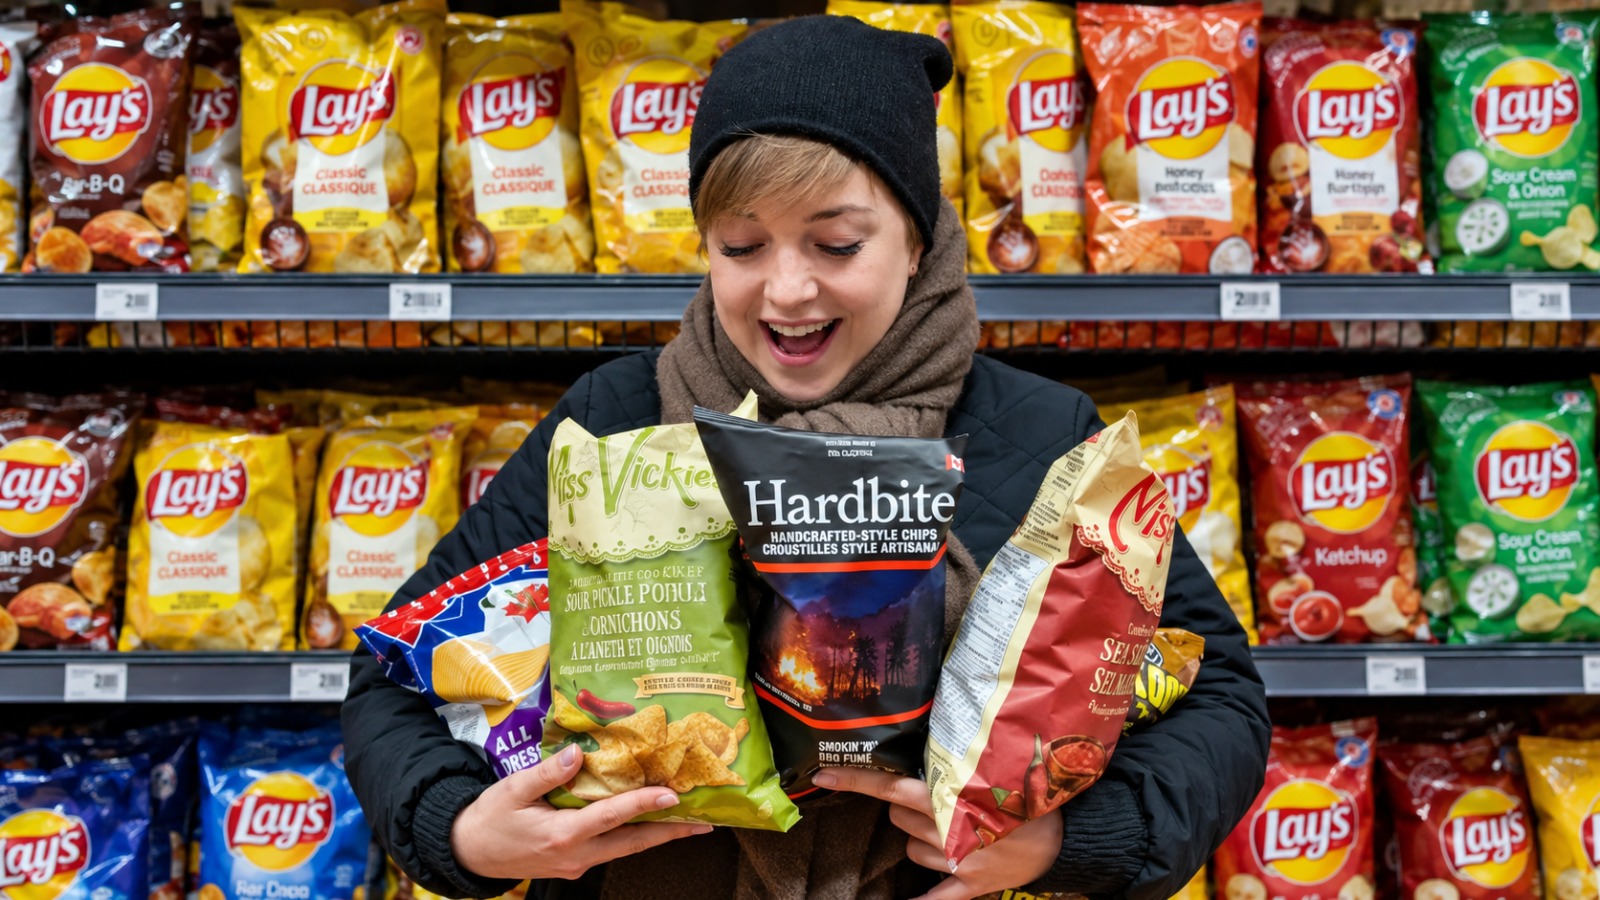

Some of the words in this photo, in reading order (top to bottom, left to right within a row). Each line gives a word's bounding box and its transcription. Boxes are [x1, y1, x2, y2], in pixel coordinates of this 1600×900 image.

[50, 87, 143, 141] Lay's
[301, 73, 388, 137] Lay's
[472, 74, 554, 133] Lay's
[1138, 77, 1230, 139] Lay's
[1307, 84, 1396, 139] Lay's
[1485, 80, 1575, 136] Lay's
[316, 166, 367, 181] Classic
[492, 165, 544, 179] Classic
[1492, 168, 1526, 184] Sour
[1531, 166, 1577, 183] Cream
[303, 181, 378, 196] CLASSIQUE
[482, 180, 556, 195] CLASSIQUE
[632, 184, 690, 198] CLASSIQ
[1522, 182, 1566, 200] Onion
[1488, 443, 1572, 499] Lay's
[150, 465, 243, 518] Lay's
[334, 465, 421, 518] Lay's
[1302, 454, 1388, 513] Lay's
[743, 476, 956, 527] Hardbite
[770, 529, 898, 543] HANDCRAFTED-STYLE
[901, 528, 938, 541] CHIPS
[1498, 531, 1532, 549] Sour
[1535, 530, 1582, 546] Cream
[0, 546, 55, 568] ar-B-Q
[167, 551, 218, 564] Classic
[346, 550, 396, 563] Classic
[762, 543, 839, 556] CROUSTILLES
[841, 543, 878, 555] STYLE
[1314, 545, 1388, 567] Ketchup
[1528, 547, 1572, 564] Onion
[157, 566, 229, 580] CLASSIQUE
[336, 566, 405, 579] CLASSIQUE
[592, 584, 635, 609] PICKLE
[496, 725, 532, 756] ALL
[500, 741, 542, 776] DRES
[234, 796, 329, 850] Lay's
[1264, 802, 1351, 861] Lay's
[1454, 809, 1526, 868] Lay's
